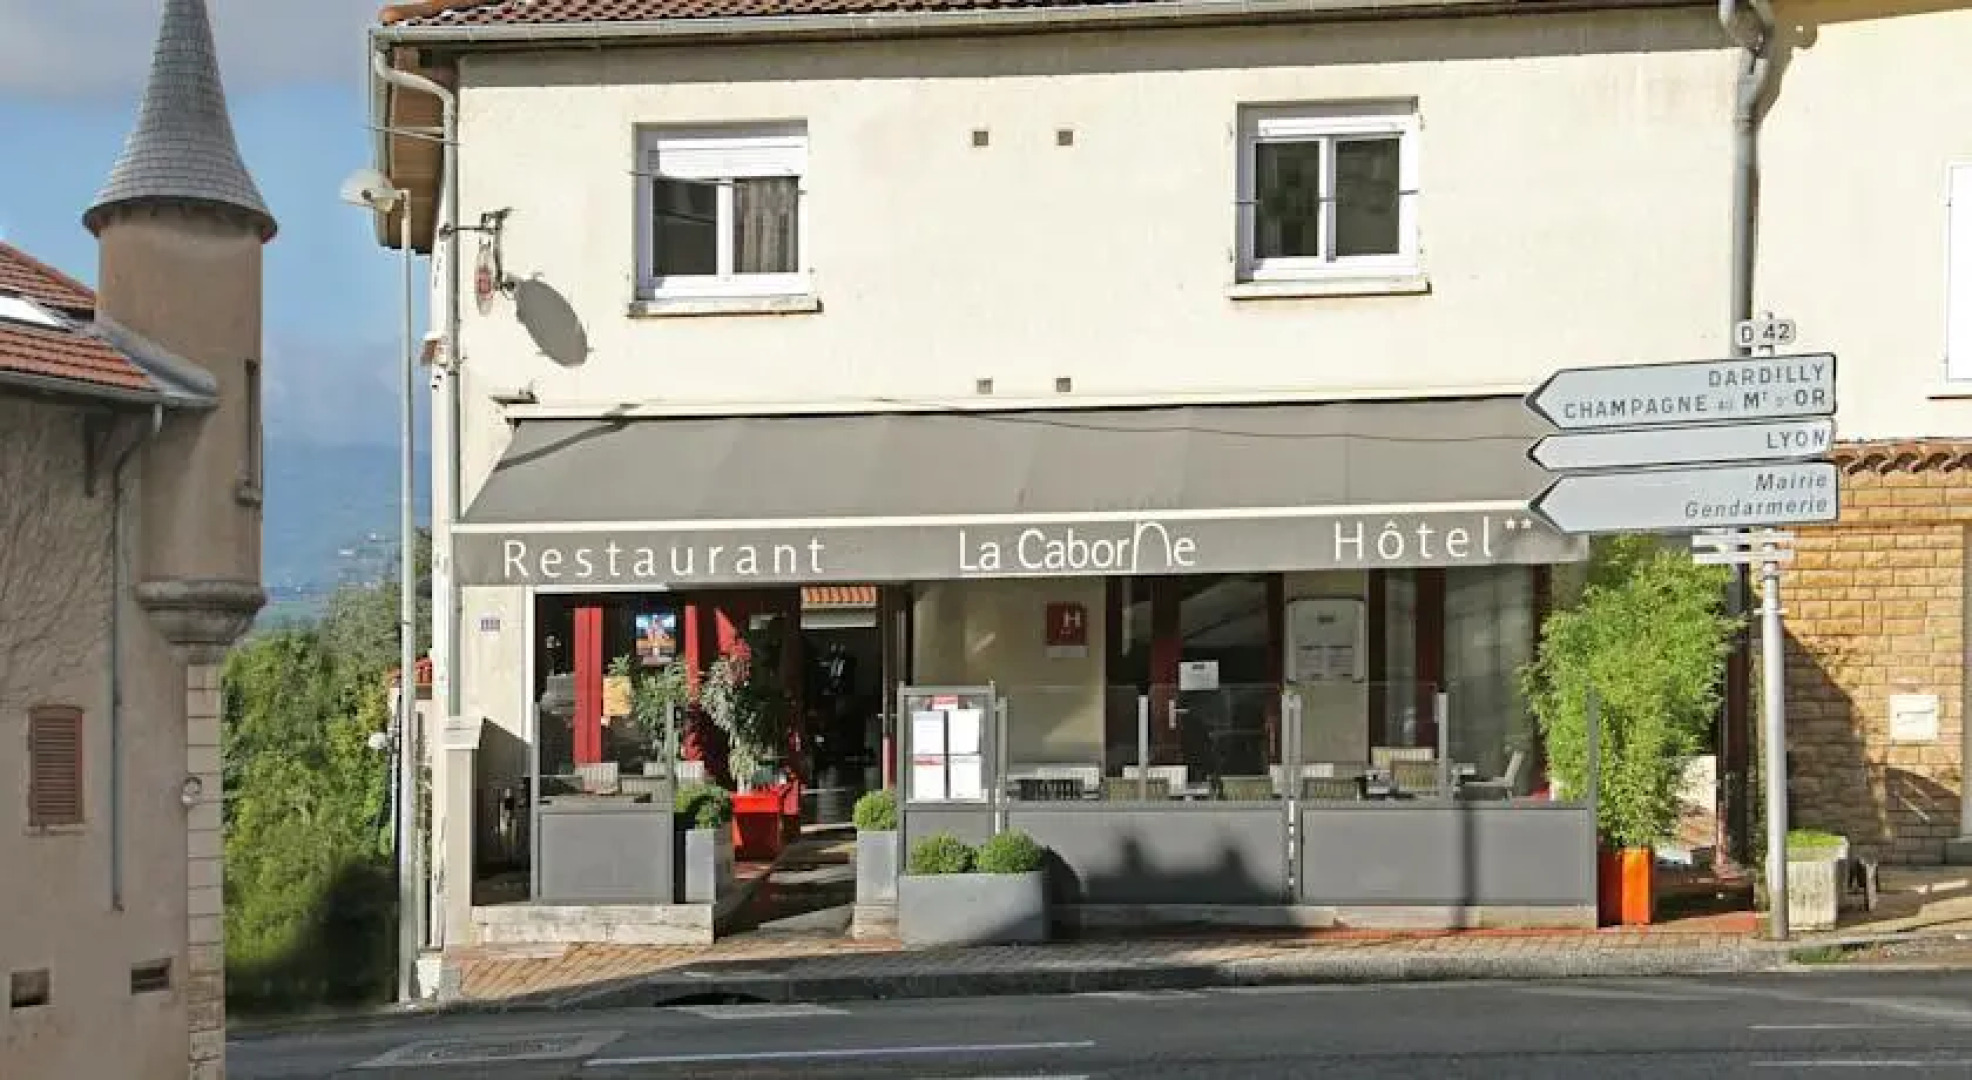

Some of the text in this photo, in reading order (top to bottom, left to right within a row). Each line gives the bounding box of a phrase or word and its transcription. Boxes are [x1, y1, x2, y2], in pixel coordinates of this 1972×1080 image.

[1742, 323, 1790, 343] D 42
[1708, 363, 1825, 387] DARDILLY
[1565, 395, 1708, 419] CHAMPAGNE
[1766, 430, 1826, 449] LYON
[1755, 471, 1828, 491] Mairie
[1684, 494, 1828, 518] Gendarmerie
[959, 529, 1001, 571] La
[1334, 516, 1492, 561] Hôtel
[503, 536, 826, 578] Restaurant
[1062, 611, 1081, 628] H
